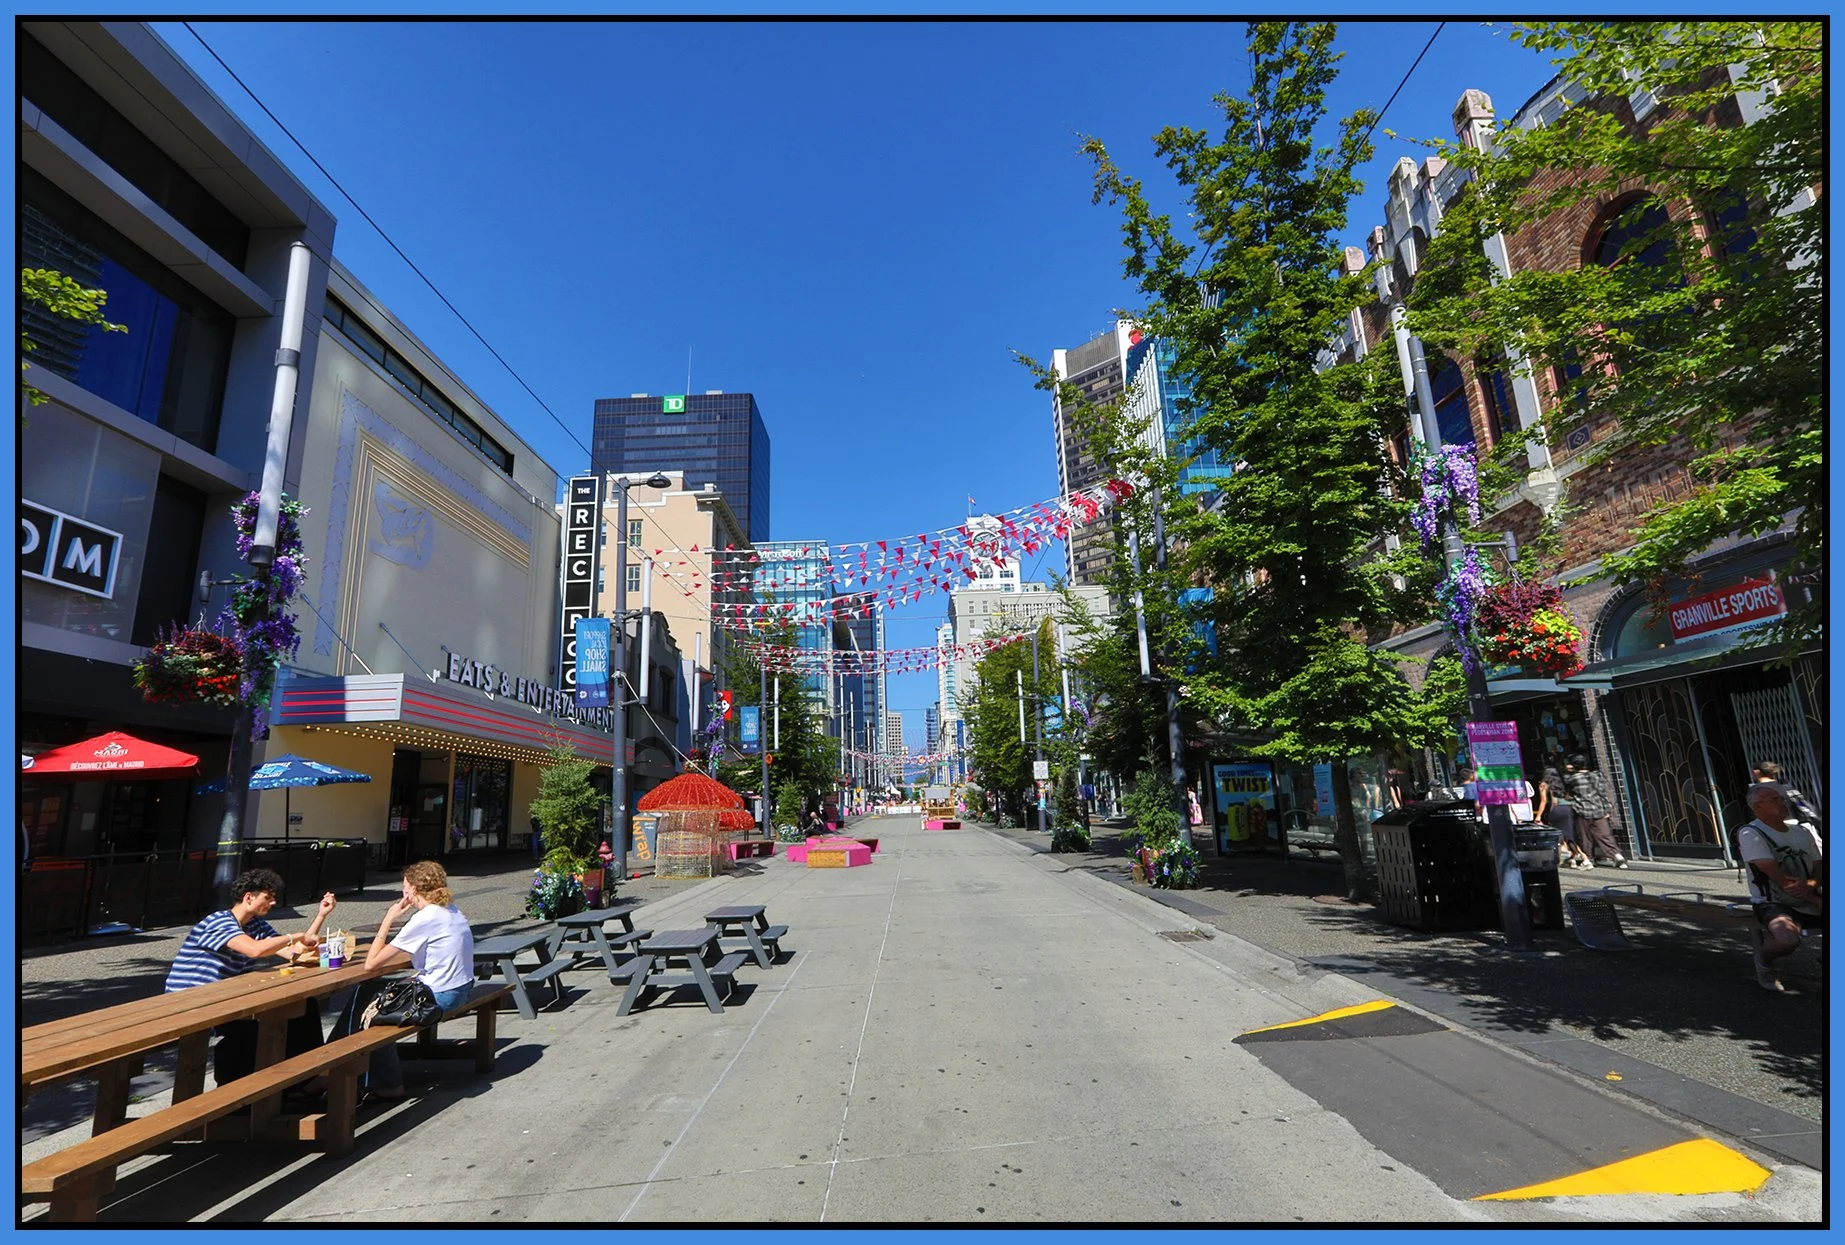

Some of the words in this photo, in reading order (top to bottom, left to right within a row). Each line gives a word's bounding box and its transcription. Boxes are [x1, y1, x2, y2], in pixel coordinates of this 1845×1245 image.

[665, 398, 683, 410] TD
[572, 509, 589, 576] REC
[1672, 597, 1730, 630] GRANVILLE
[1730, 583, 1778, 616] SPORTS
[449, 652, 494, 692] EATS
[500, 671, 511, 698] &
[518, 677, 614, 729] ENTERTAINMENT
[1221, 778, 1268, 792] TWIST
